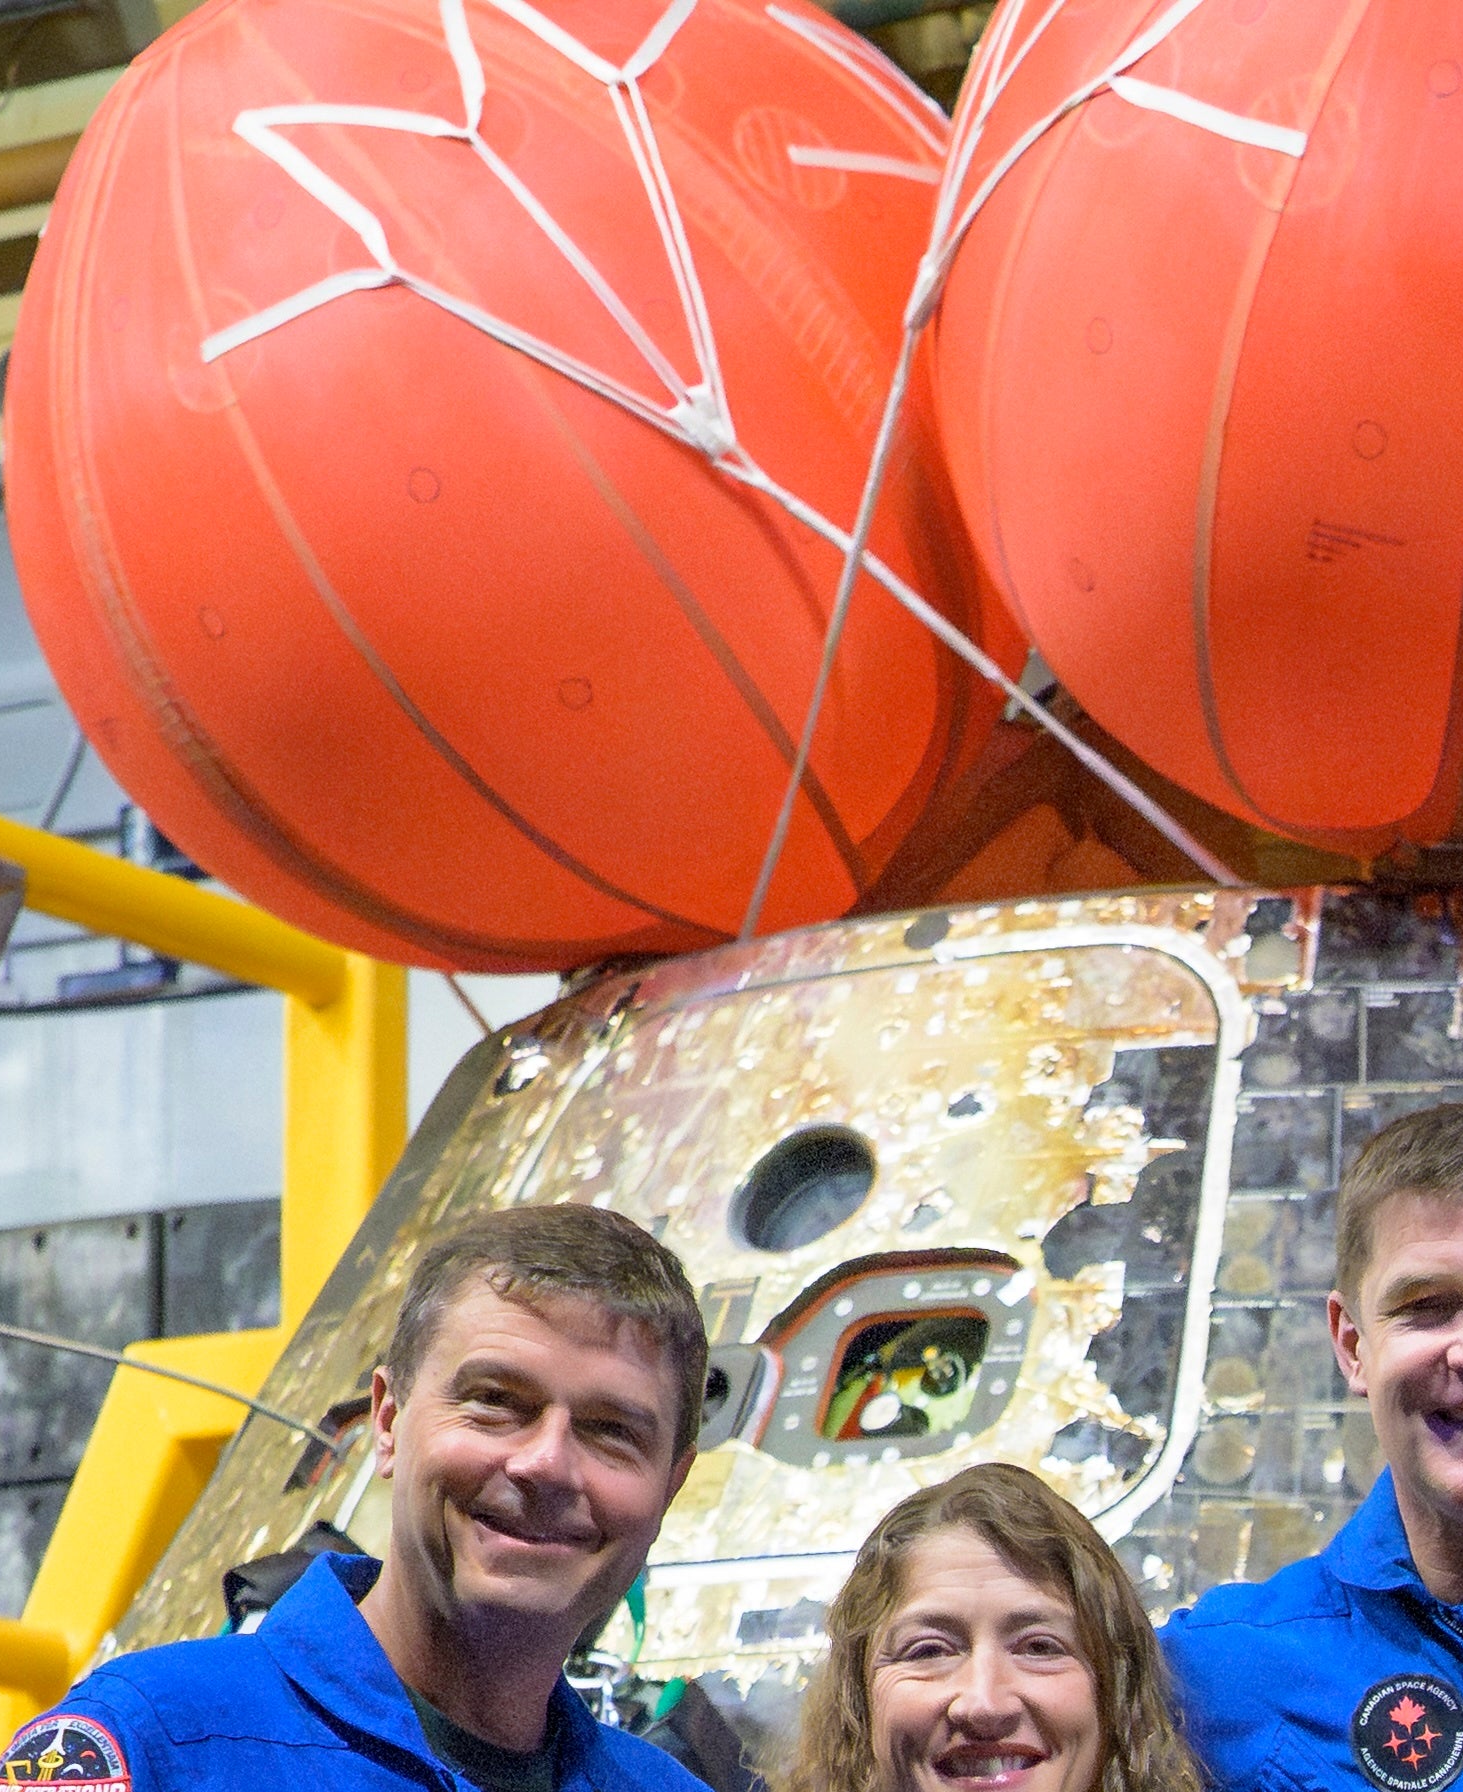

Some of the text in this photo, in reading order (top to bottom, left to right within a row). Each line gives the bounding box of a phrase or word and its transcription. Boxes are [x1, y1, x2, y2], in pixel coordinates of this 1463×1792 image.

[1359, 1681, 1459, 1726] CANADIAN SPACE AGENCY
[1360, 1747, 1387, 1782] AGENCE
[1387, 1778, 1428, 1790] SPATIALE
